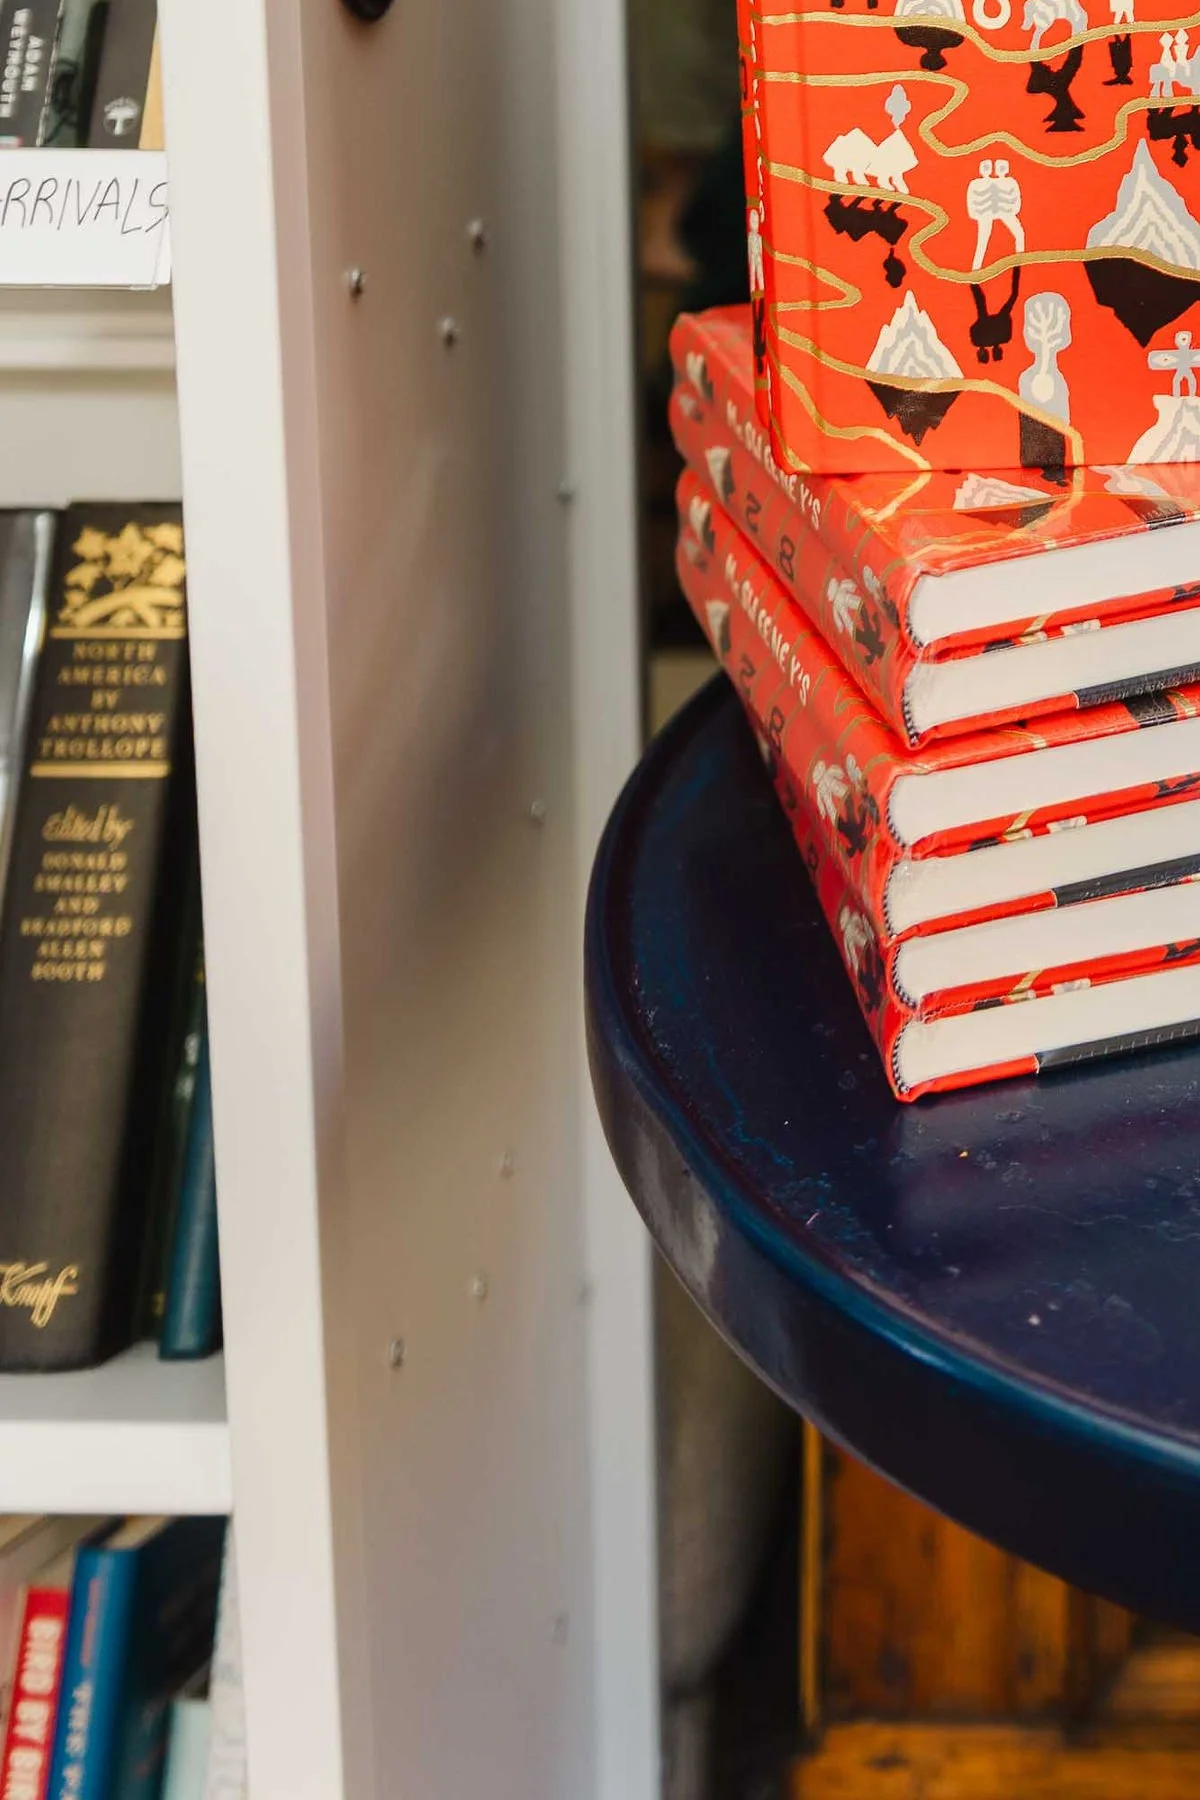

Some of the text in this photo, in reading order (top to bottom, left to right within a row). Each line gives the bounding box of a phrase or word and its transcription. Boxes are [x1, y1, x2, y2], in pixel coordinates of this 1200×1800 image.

[21, 34, 44, 92] ADAM
[72, 641, 157, 662] NORTH
[57, 663, 167, 687] AMERICA
[90, 688, 122, 710] BY
[47, 712, 166, 734] ANTHONY
[39, 735, 166, 760] TROLLOPE
[42, 852, 128, 872] DONALD
[54, 894, 100, 916] AND
[20, 915, 132, 938] BRADFORD
[38, 938, 106, 960] ALLEN
[31, 961, 106, 983] BOOTH
